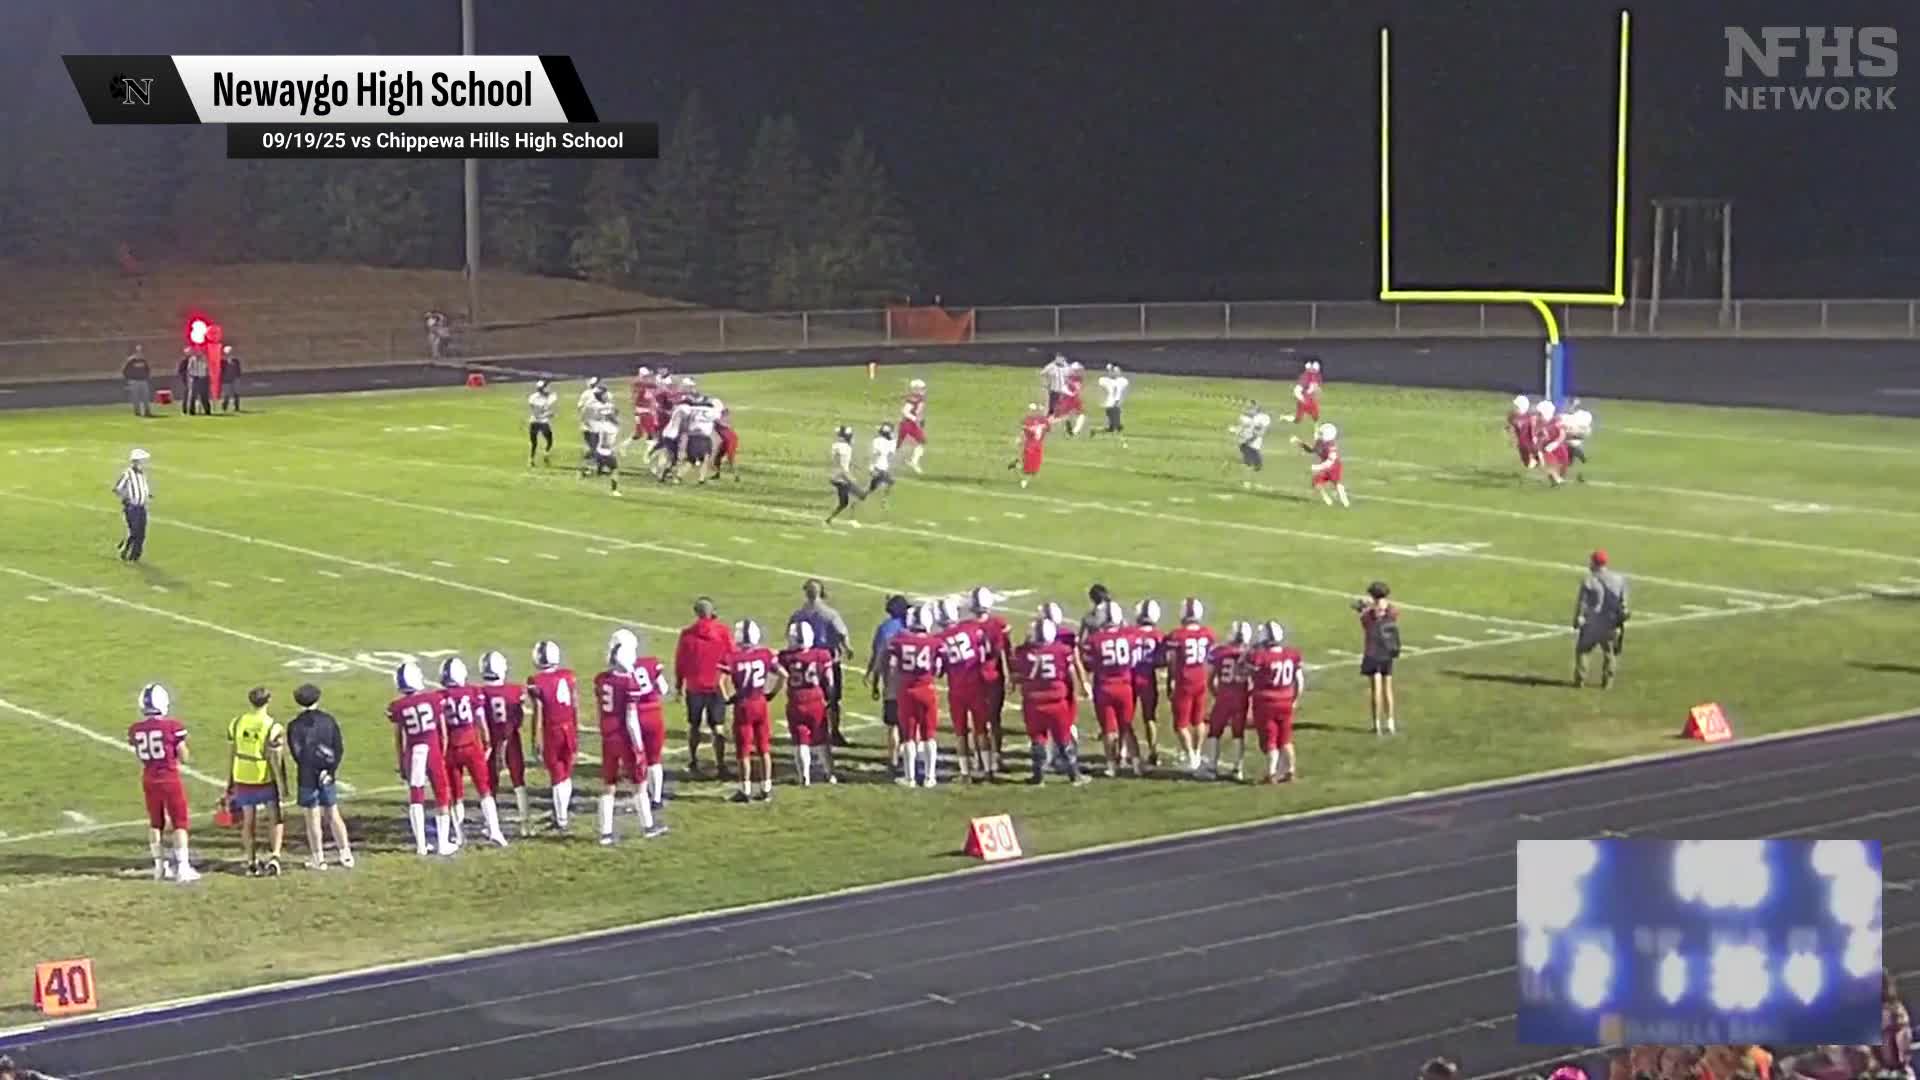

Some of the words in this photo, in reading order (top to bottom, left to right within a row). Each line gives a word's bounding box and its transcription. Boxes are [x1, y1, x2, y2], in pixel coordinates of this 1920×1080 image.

[901, 644, 931, 671] 54
[1101, 637, 1130, 665] 50
[737, 660, 766, 688] 72
[1027, 653, 1057, 678] 75
[1270, 659, 1294, 686] 70
[556, 678, 571, 706] 4
[402, 702, 437, 735] 32
[135, 730, 166, 760] 26
[978, 820, 1014, 853] 30
[45, 965, 90, 1006] 40
